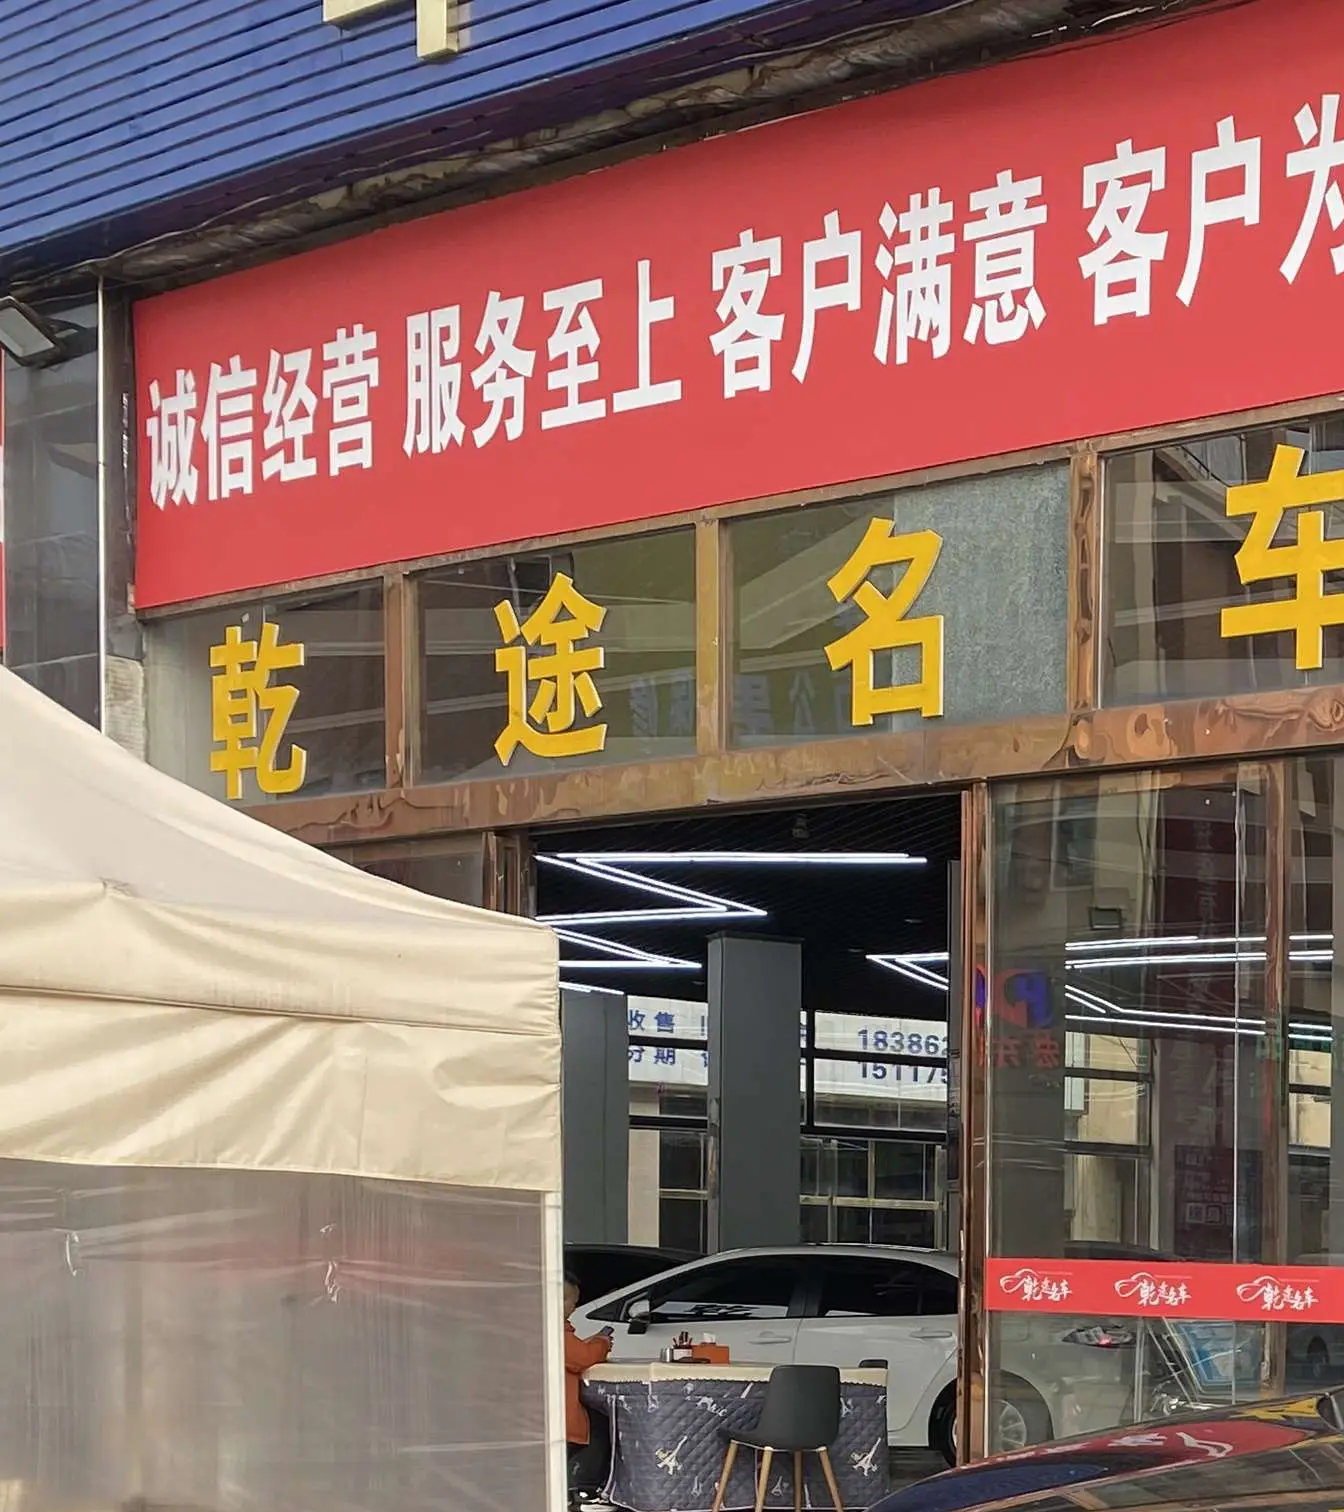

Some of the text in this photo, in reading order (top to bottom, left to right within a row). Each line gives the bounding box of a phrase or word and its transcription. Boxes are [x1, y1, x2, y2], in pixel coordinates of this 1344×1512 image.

[146, 322, 380, 510] 诚信经营
[402, 258, 683, 458] 服务至上
[709, 169, 1048, 399] 客户满意
